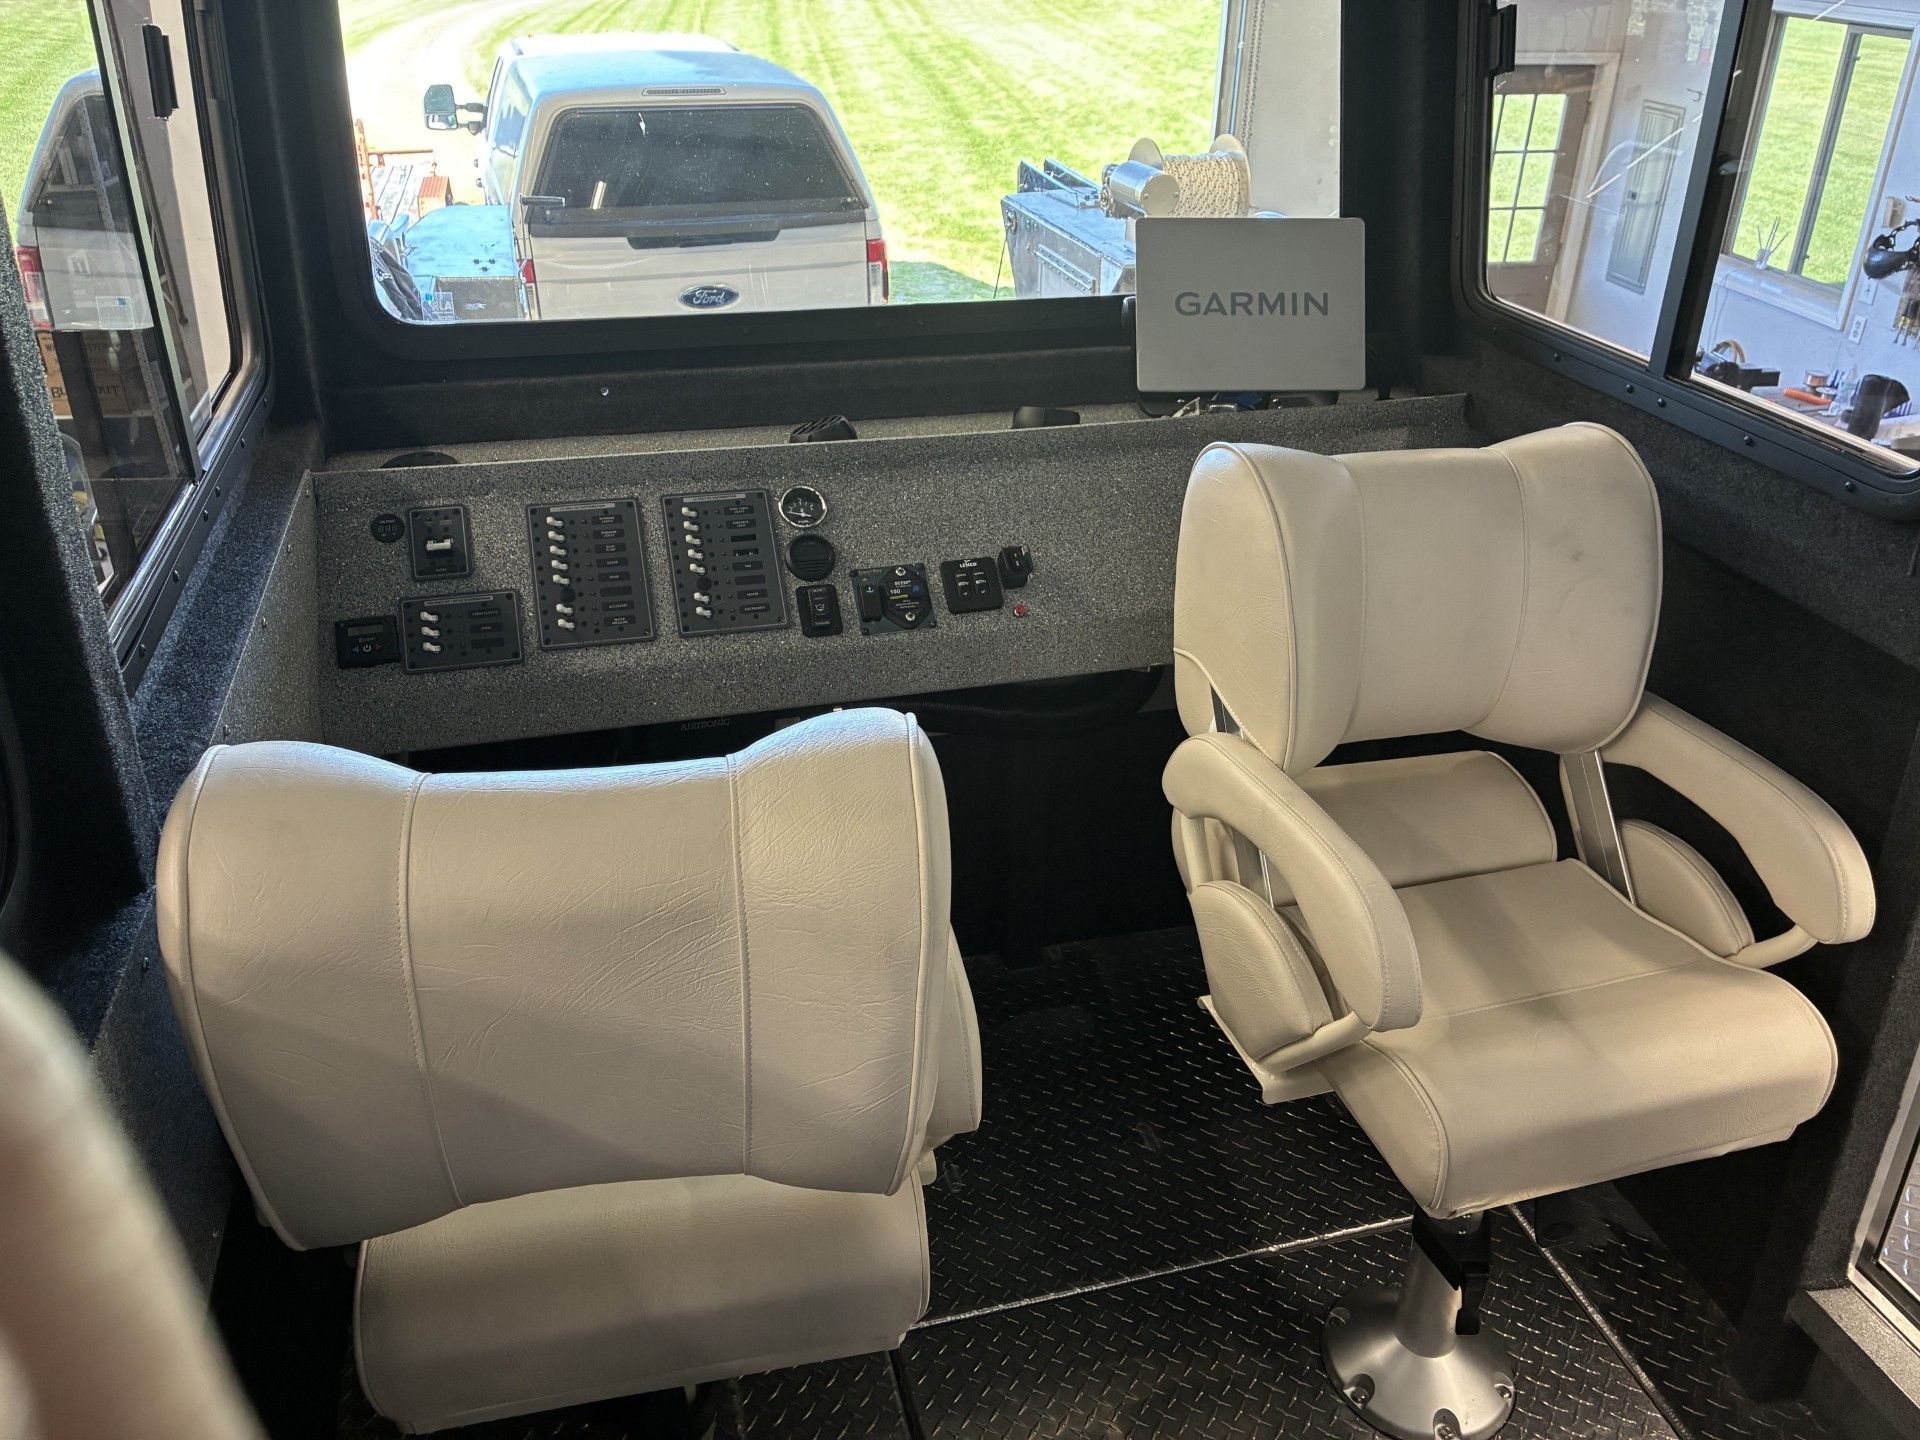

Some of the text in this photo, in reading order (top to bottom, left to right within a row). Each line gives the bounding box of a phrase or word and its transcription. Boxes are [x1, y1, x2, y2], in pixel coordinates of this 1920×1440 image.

[692, 289, 725, 304] Ford
[1175, 292, 1328, 316] GARMIN
[959, 561, 977, 569] LENCO
